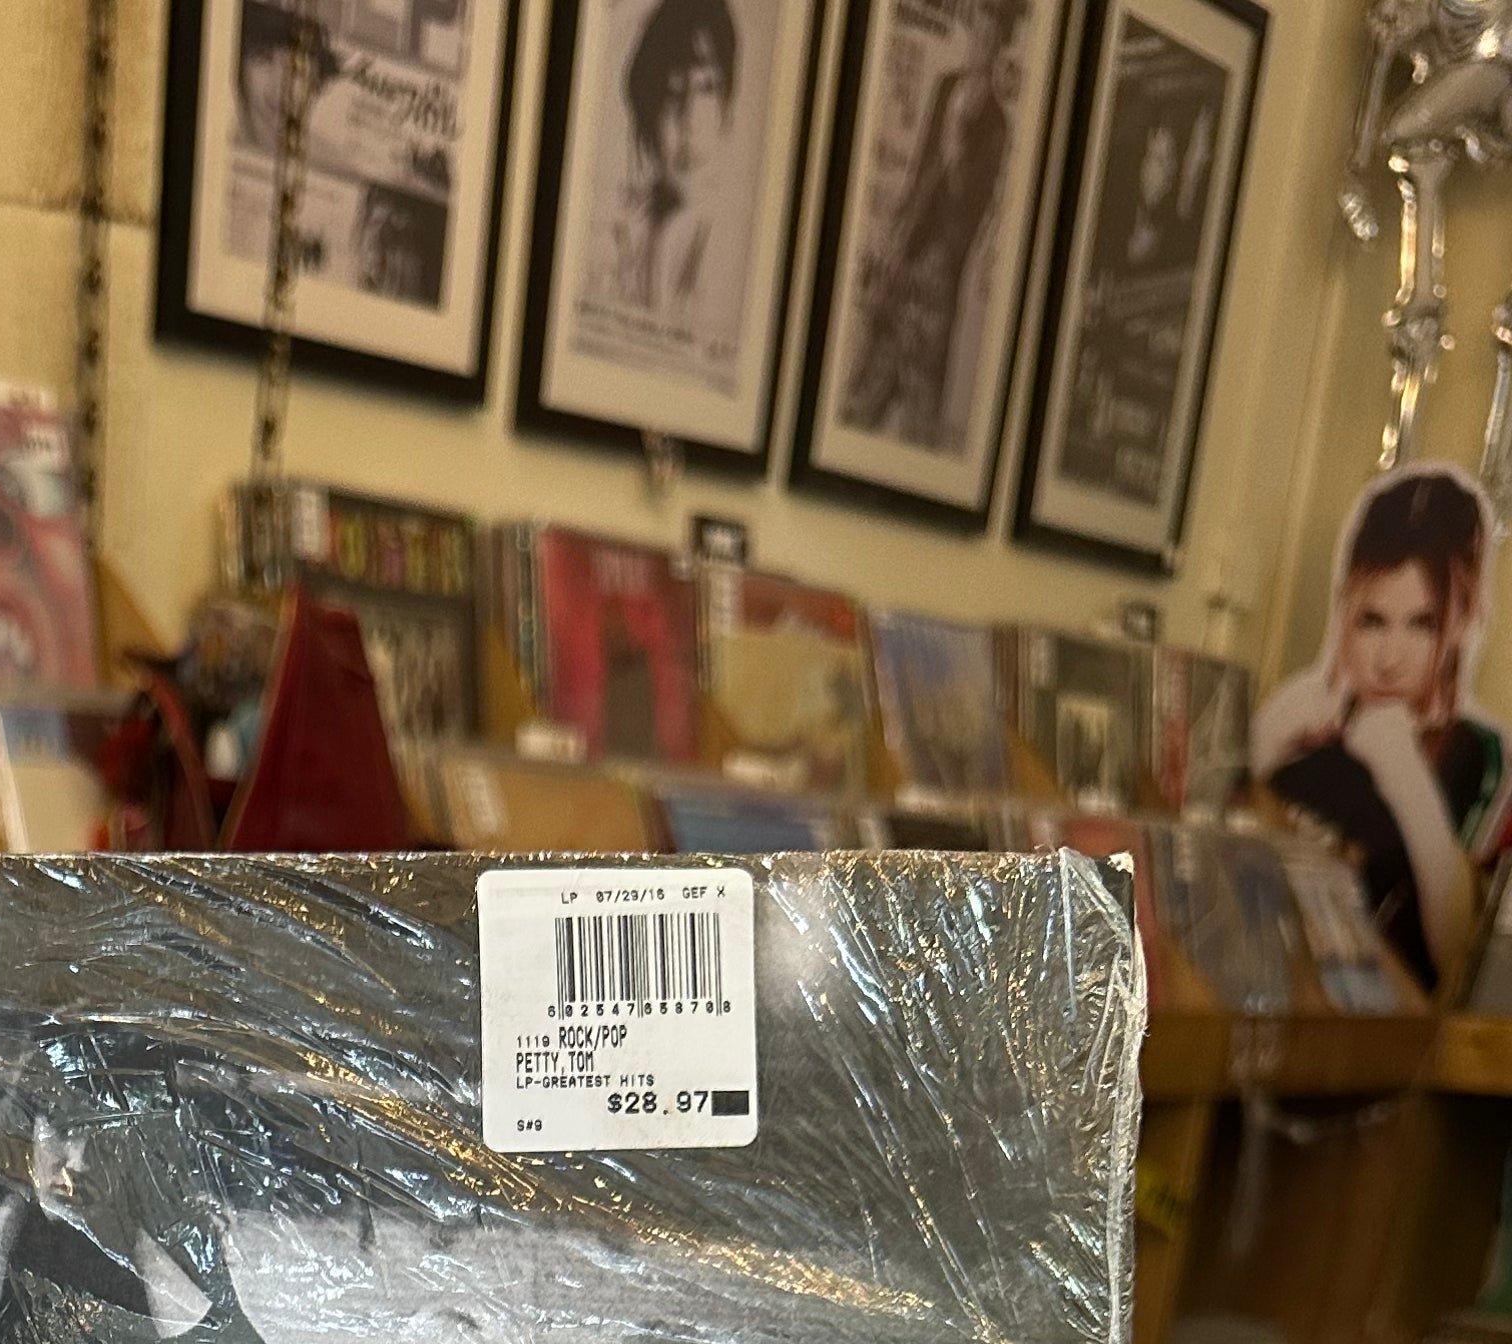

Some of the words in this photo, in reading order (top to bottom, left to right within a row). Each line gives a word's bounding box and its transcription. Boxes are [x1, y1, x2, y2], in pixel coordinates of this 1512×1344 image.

[561, 892, 578, 904] LP
[682, 886, 708, 899] GEF
[558, 1024, 628, 1050] ROCK/POP
[516, 1075, 611, 1089] LP-GREATEST
[619, 1074, 655, 1087] HITS
[606, 1090, 709, 1115] $28.97
